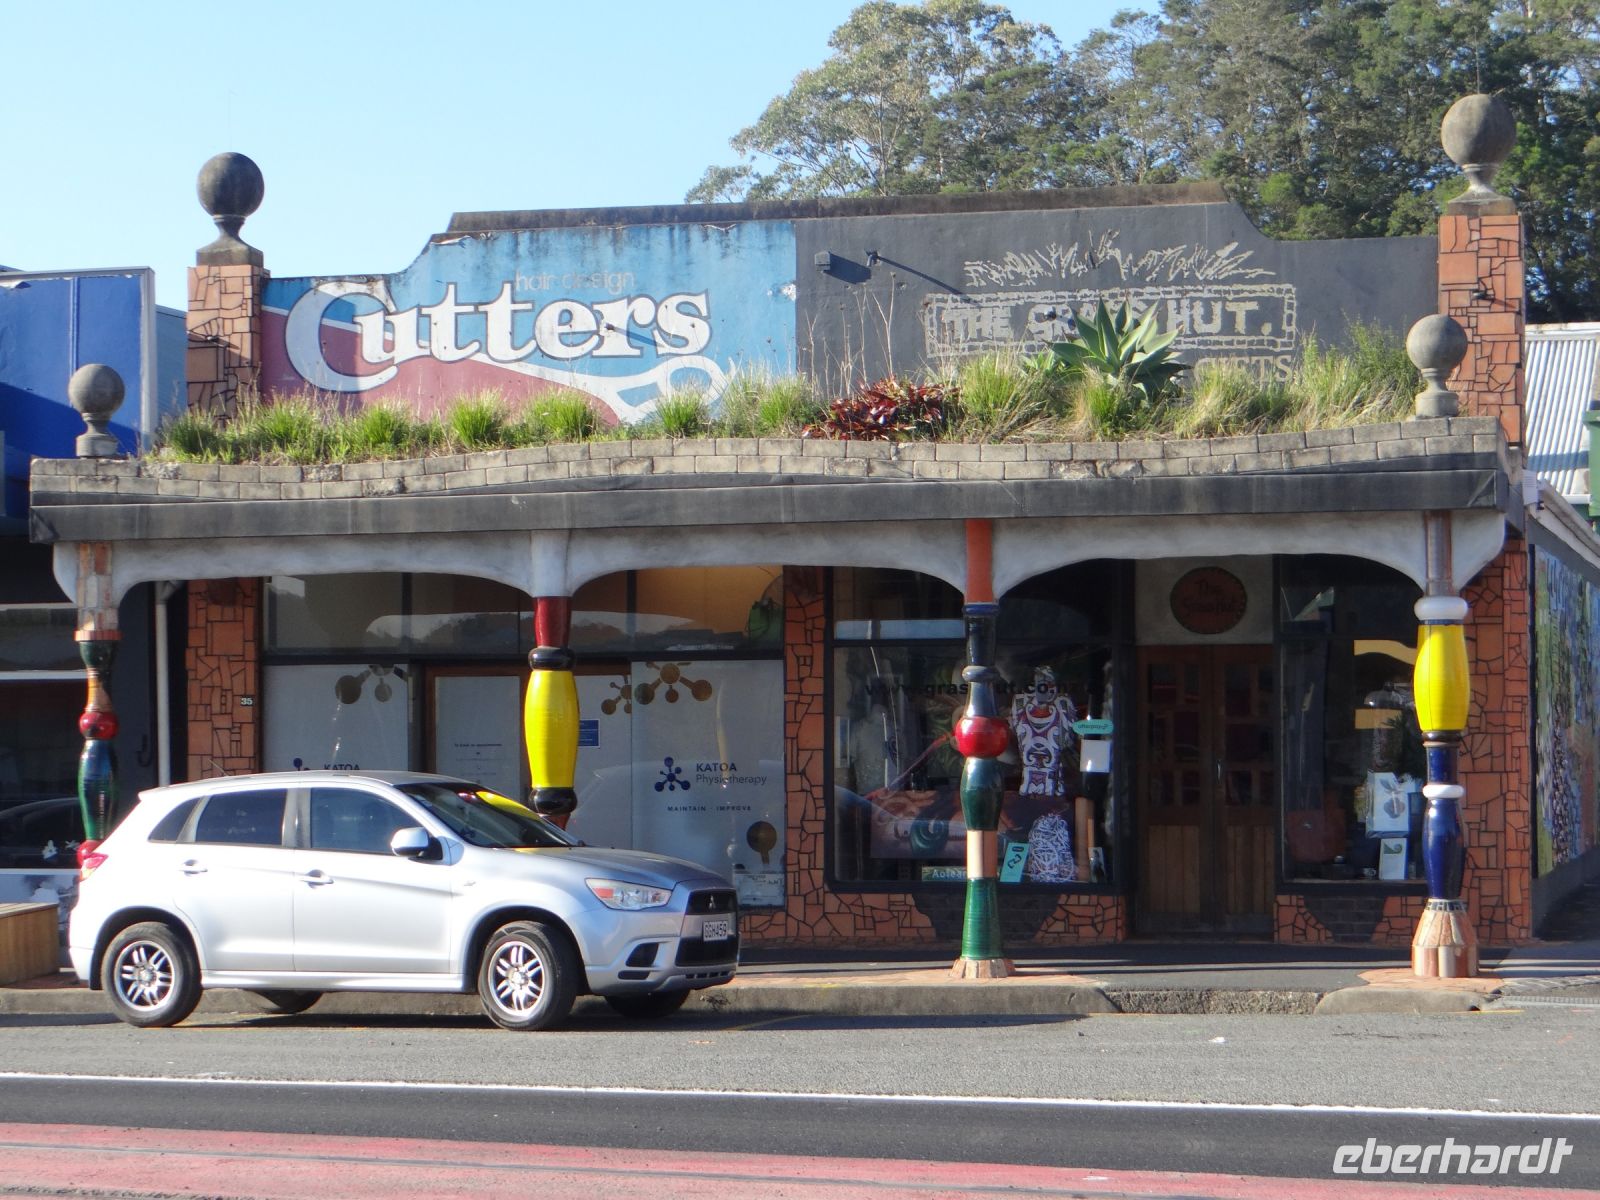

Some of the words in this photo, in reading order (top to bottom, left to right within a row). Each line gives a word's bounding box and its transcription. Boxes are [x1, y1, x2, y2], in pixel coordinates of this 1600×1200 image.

[515, 271, 557, 290] hair
[562, 271, 634, 295] design
[941, 306, 1011, 341] THE
[285, 280, 712, 393] Cutters
[240, 697, 254, 705] 35
[696, 762, 737, 773] KATOA
[696, 774, 767, 786] Physiotherapy
